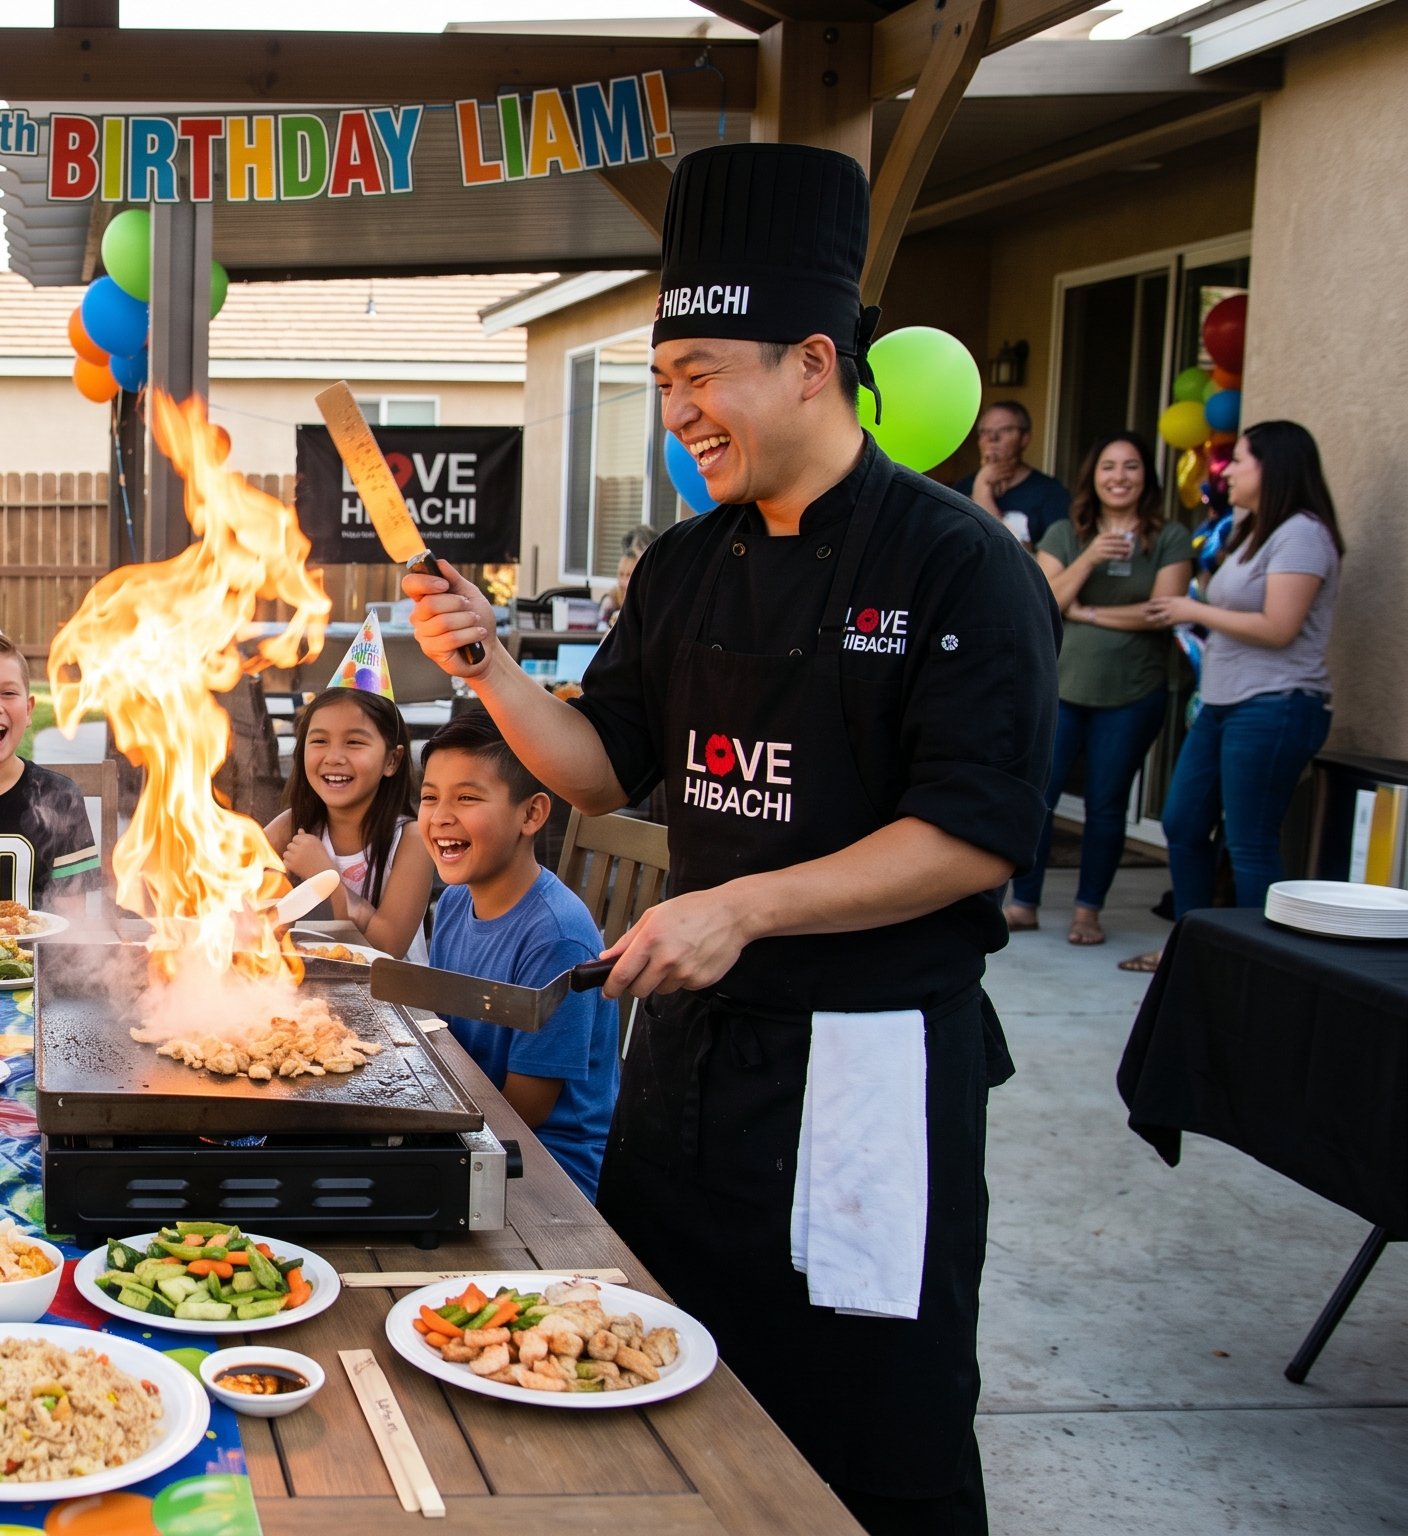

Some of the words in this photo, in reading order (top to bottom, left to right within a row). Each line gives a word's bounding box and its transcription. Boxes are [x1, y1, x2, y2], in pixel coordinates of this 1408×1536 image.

[48, 104, 424, 203] BIRTHDAY
[455, 70, 677, 187] LIAM!
[662, 285, 750, 318] HIBACHI
[341, 498, 476, 525] HACHI
[844, 606, 909, 634] LOVE
[686, 729, 792, 785] LOVE
[683, 776, 792, 823] HIBACHI
